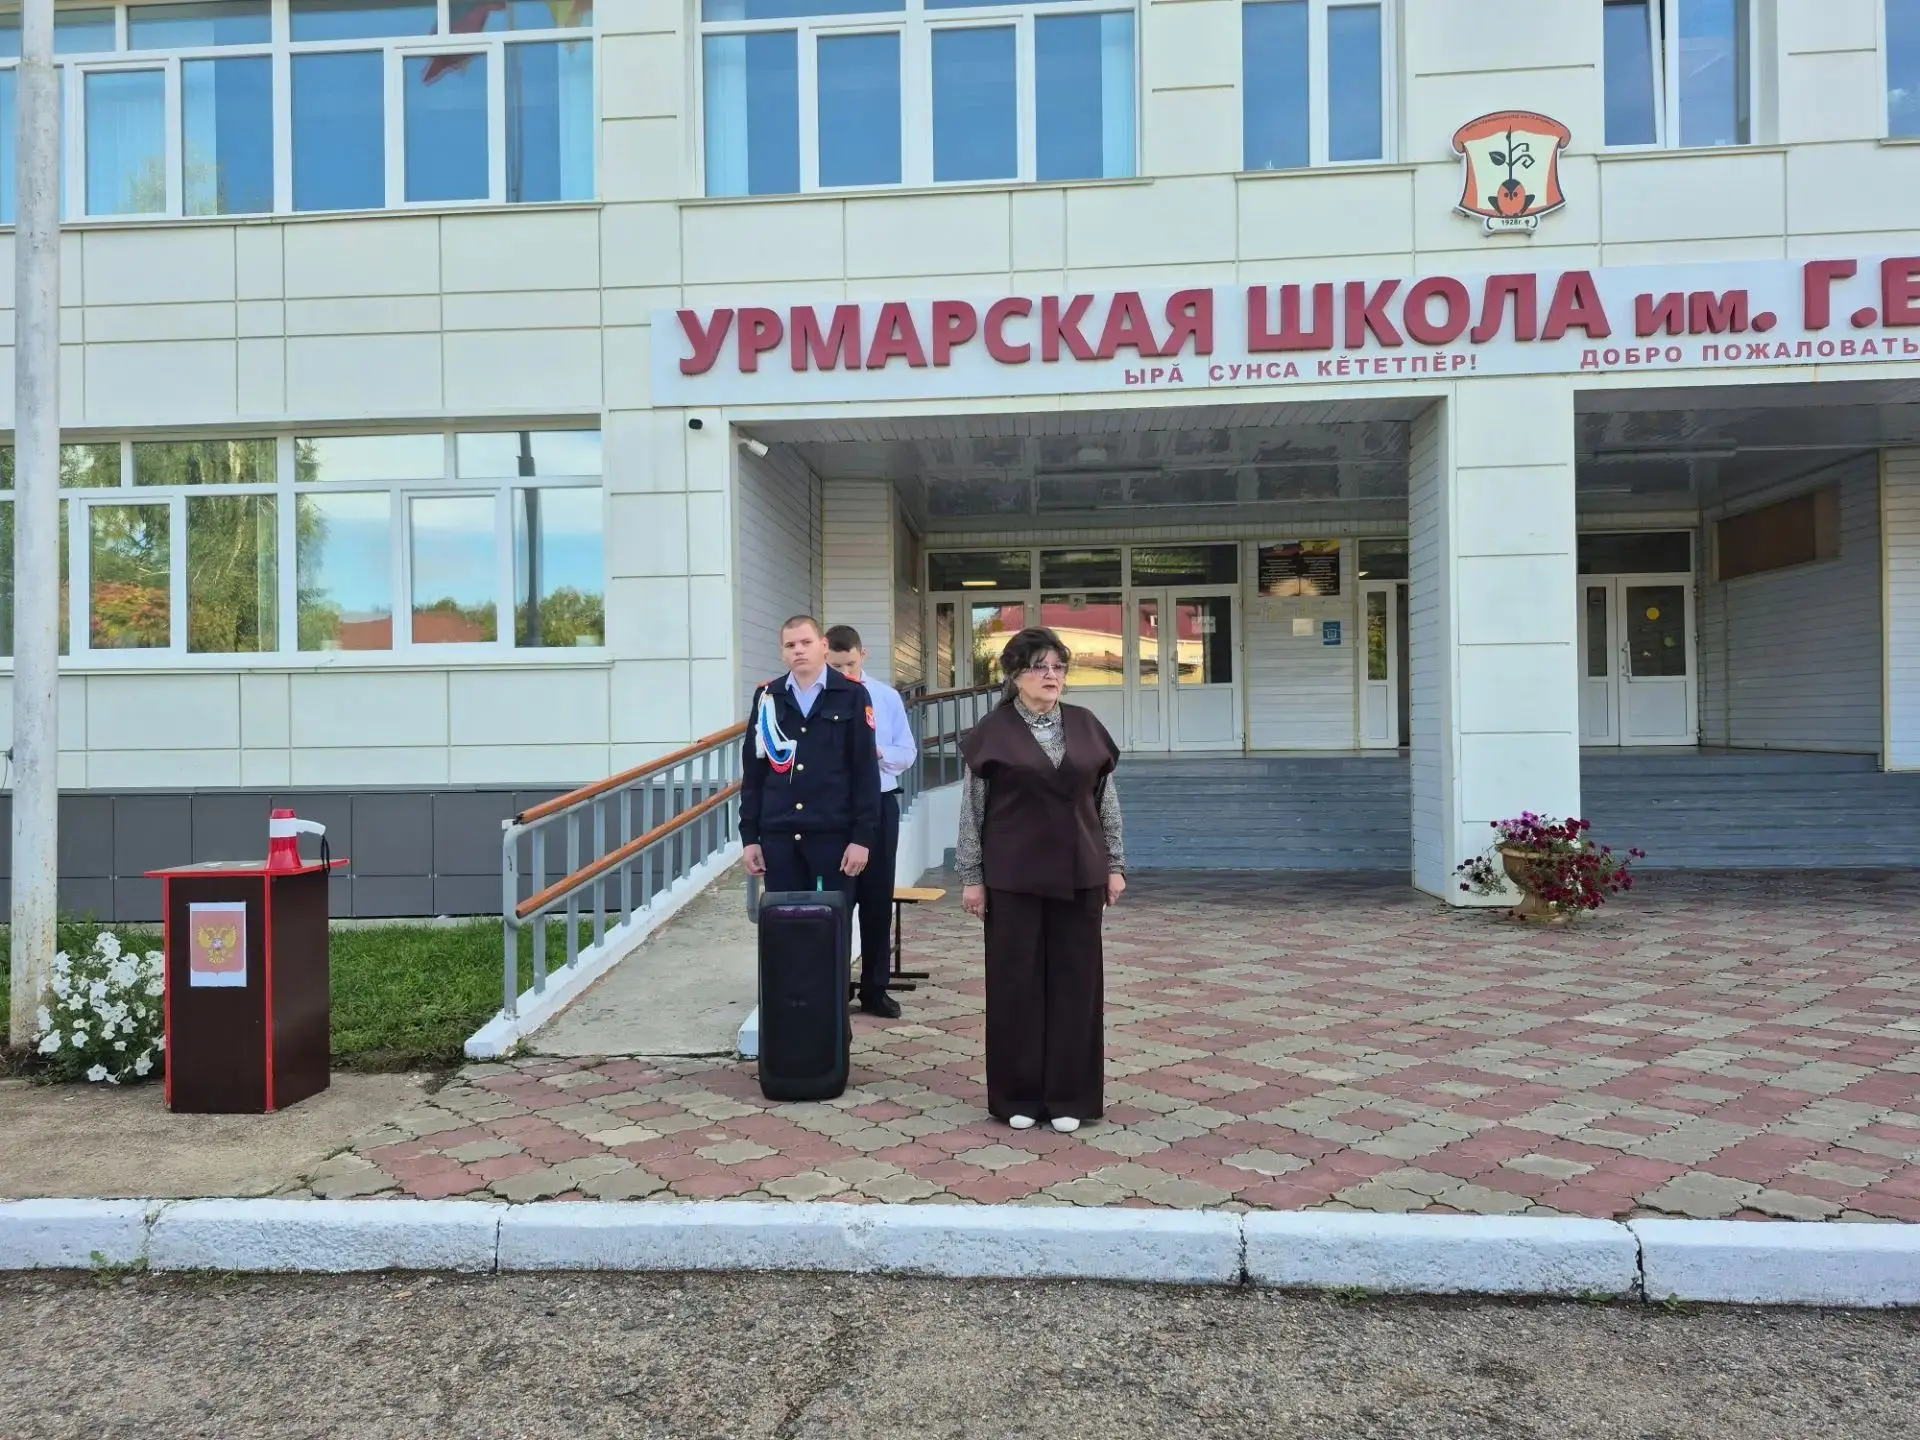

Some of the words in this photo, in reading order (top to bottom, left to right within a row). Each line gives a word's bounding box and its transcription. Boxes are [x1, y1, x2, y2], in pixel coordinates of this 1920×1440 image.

[676, 288, 1213, 375] УРМАРСКАЯ
[1247, 270, 1611, 353] ШКОЛА
[1635, 289, 1777, 338] им.
[1580, 346, 1683, 370] ДОБРО
[1702, 337, 1919, 362] ПОЖАЛОВАТЬ
[1209, 361, 1300, 382] СУНСА
